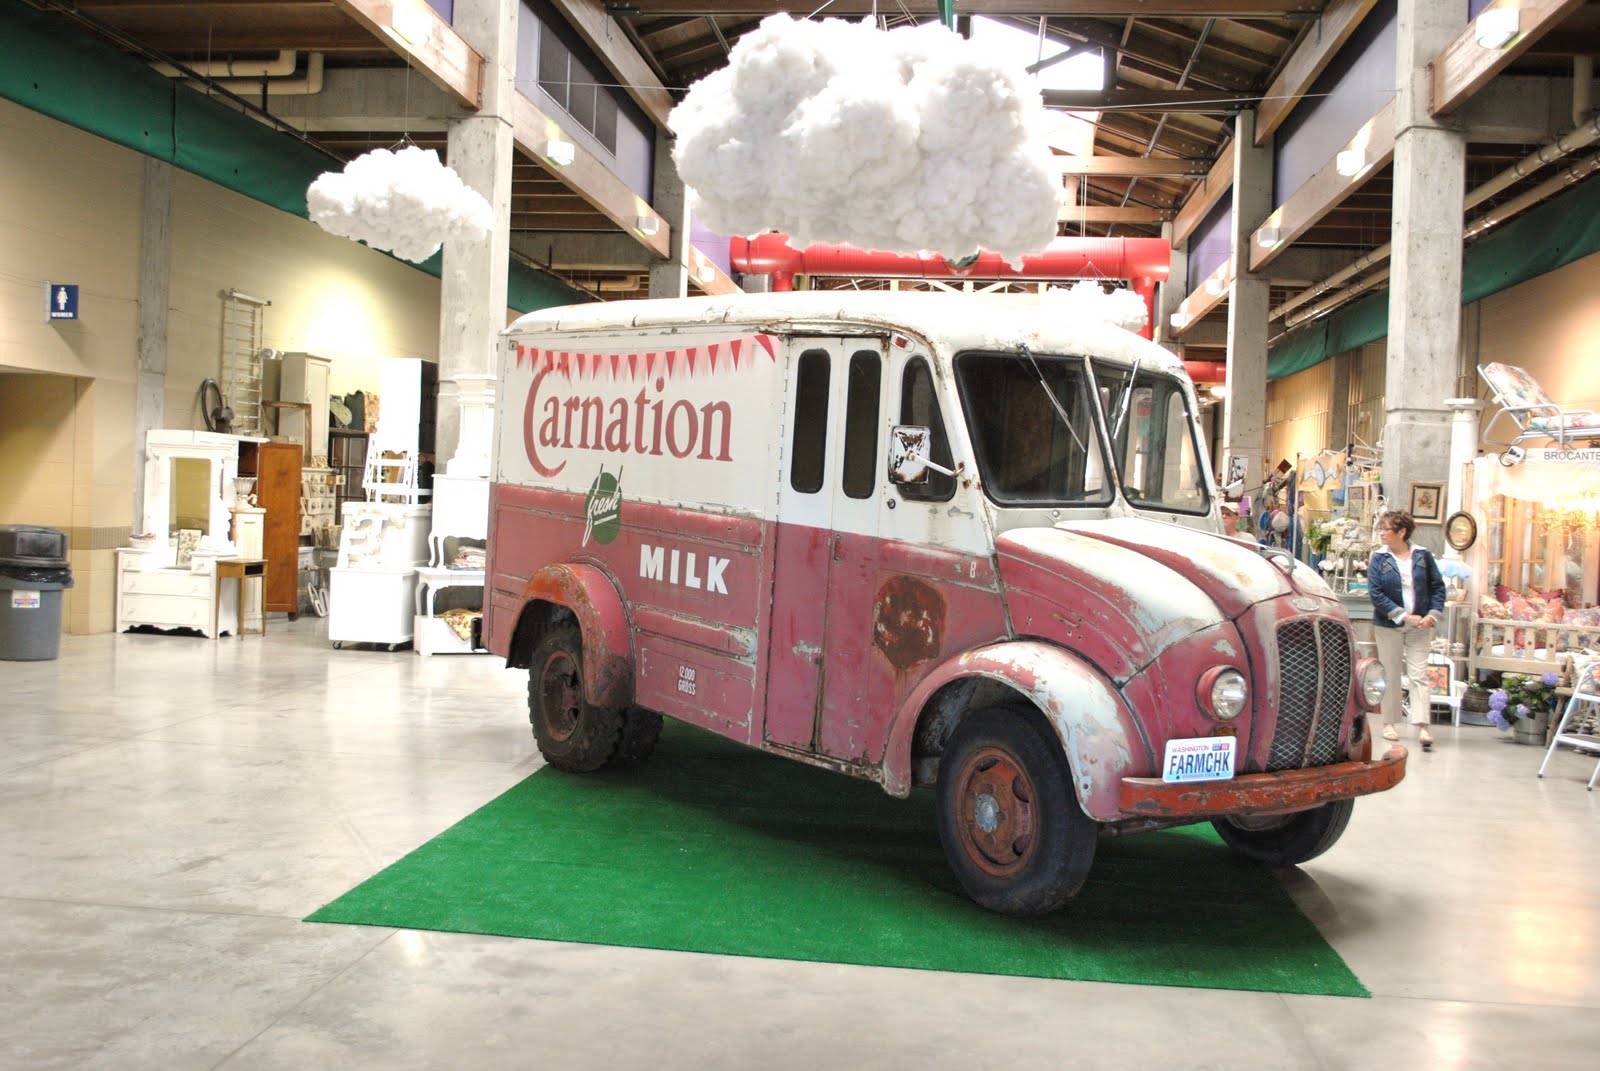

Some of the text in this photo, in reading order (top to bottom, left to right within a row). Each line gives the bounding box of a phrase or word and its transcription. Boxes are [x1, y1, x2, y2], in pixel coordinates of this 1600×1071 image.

[523, 360, 733, 477] Carnation
[1543, 451, 1600, 460] BROCANTE
[639, 544, 731, 595] MILK
[678, 679, 696, 696] GROSS
[1169, 752, 1230, 775] FARMCHK
